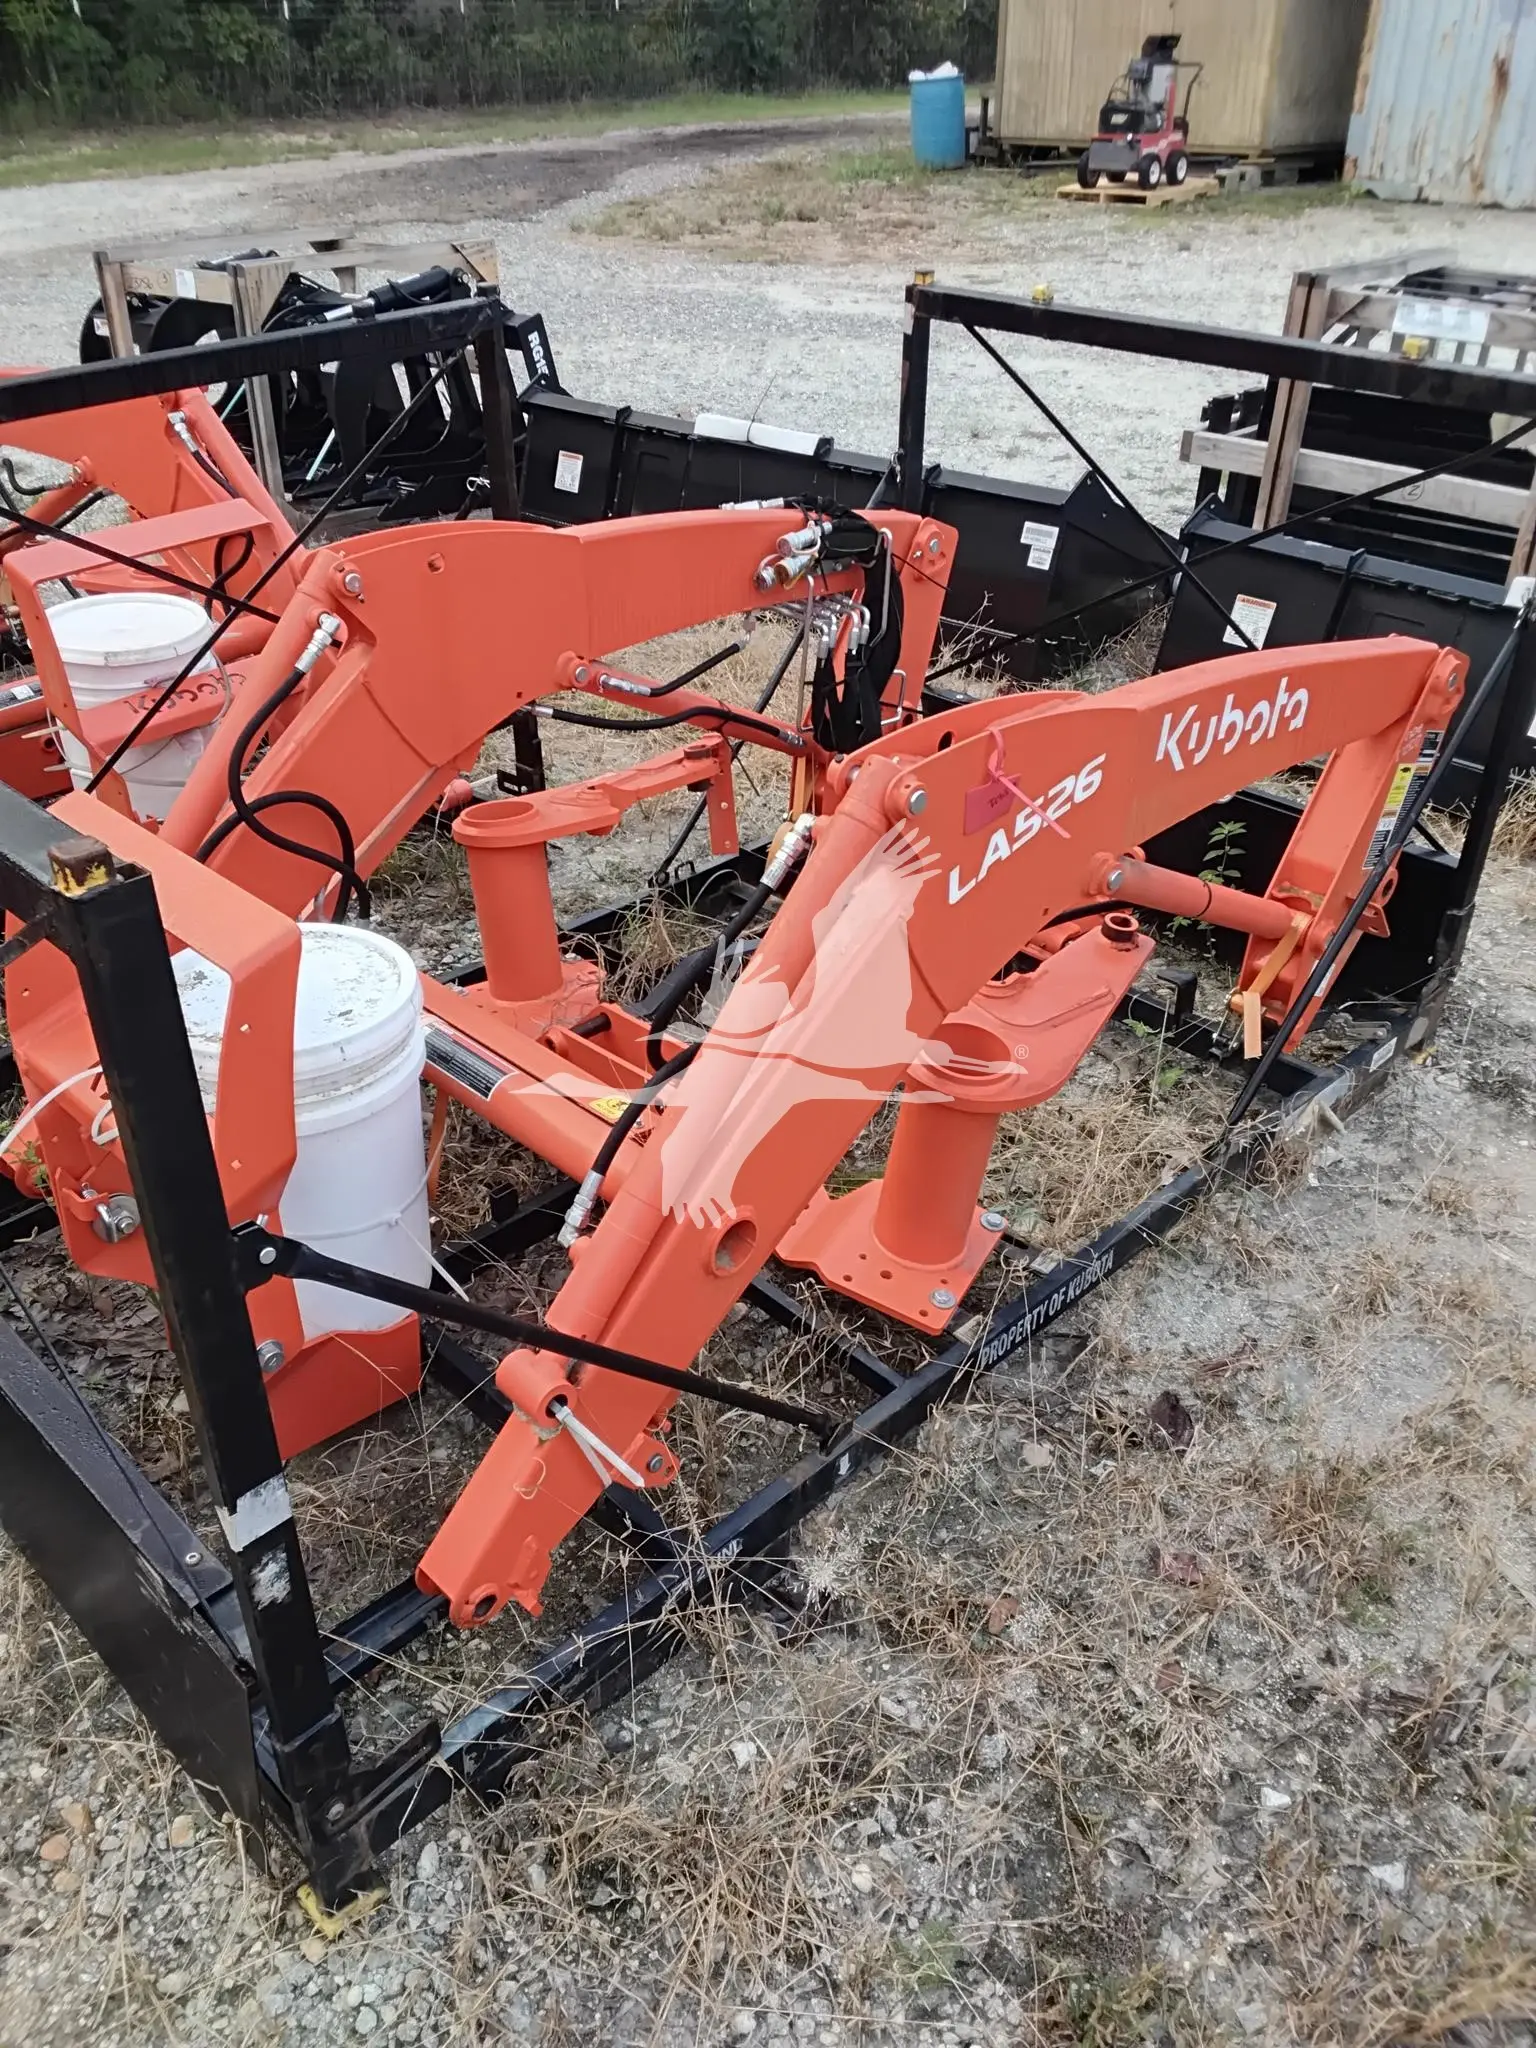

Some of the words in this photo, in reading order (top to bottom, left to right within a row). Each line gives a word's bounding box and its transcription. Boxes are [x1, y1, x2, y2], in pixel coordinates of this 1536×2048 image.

[1155, 676, 1309, 772] Kubota
[948, 753, 1107, 905] LA526
[981, 1300, 1049, 1369] PROPERTY
[1048, 1286, 1067, 1316] OF
[1066, 1248, 1115, 1303] KUBOTA
